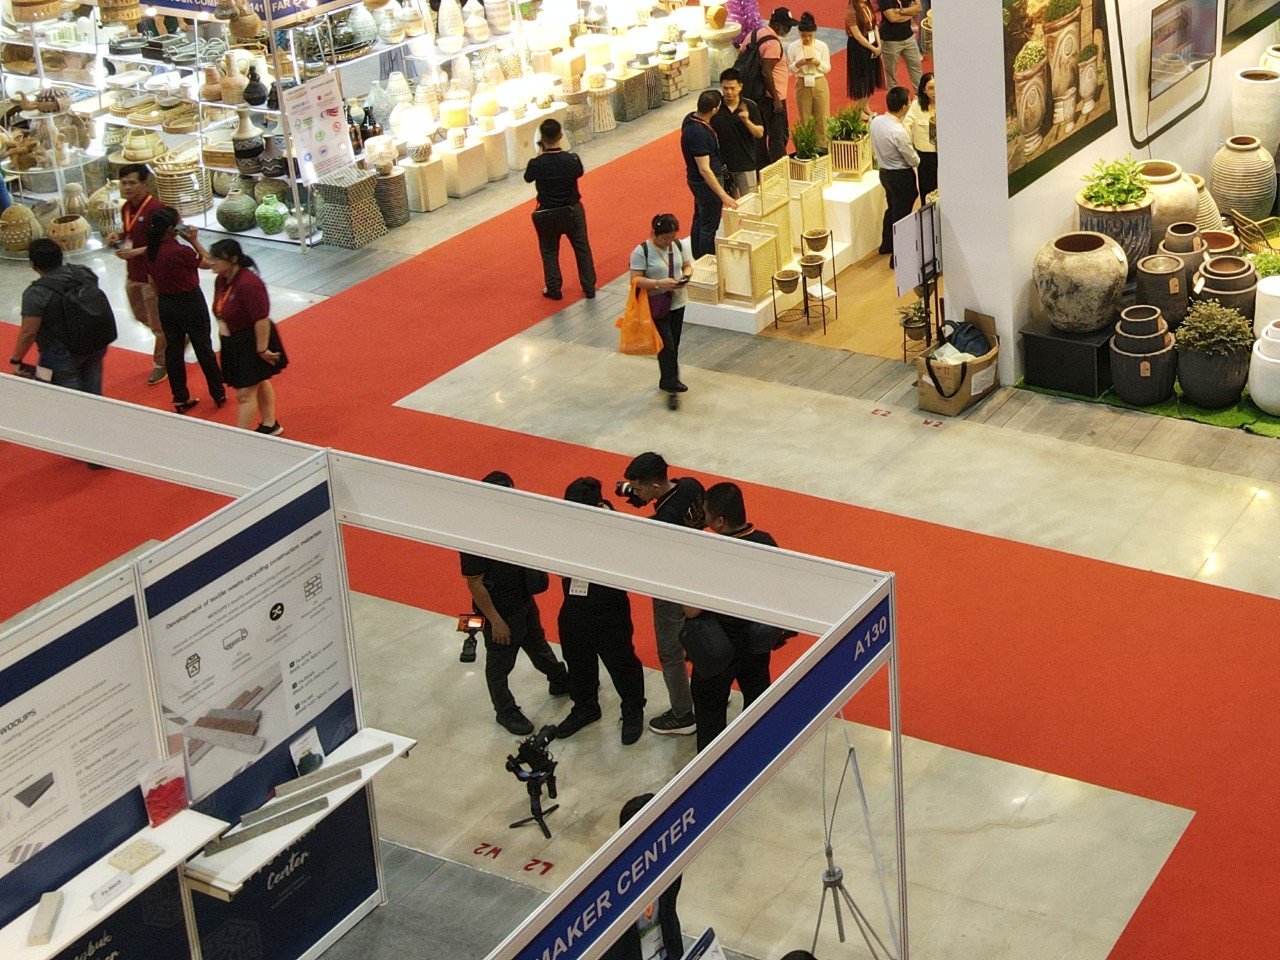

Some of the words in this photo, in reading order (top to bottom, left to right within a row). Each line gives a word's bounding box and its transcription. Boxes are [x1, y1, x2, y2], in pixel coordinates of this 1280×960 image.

[272, 0, 291, 12] FAR
[166, 604, 202, 630] Development
[210, 590, 227, 603] textile
[228, 579, 244, 591] waste
[245, 564, 269, 582] upcycling
[270, 544, 300, 566] construction
[300, 530, 322, 545] materials
[853, 615, 887, 662] A130
[267, 848, 310, 890] Center
[536, 890, 612, 960] MAKER
[616, 806, 697, 894] CENTER
